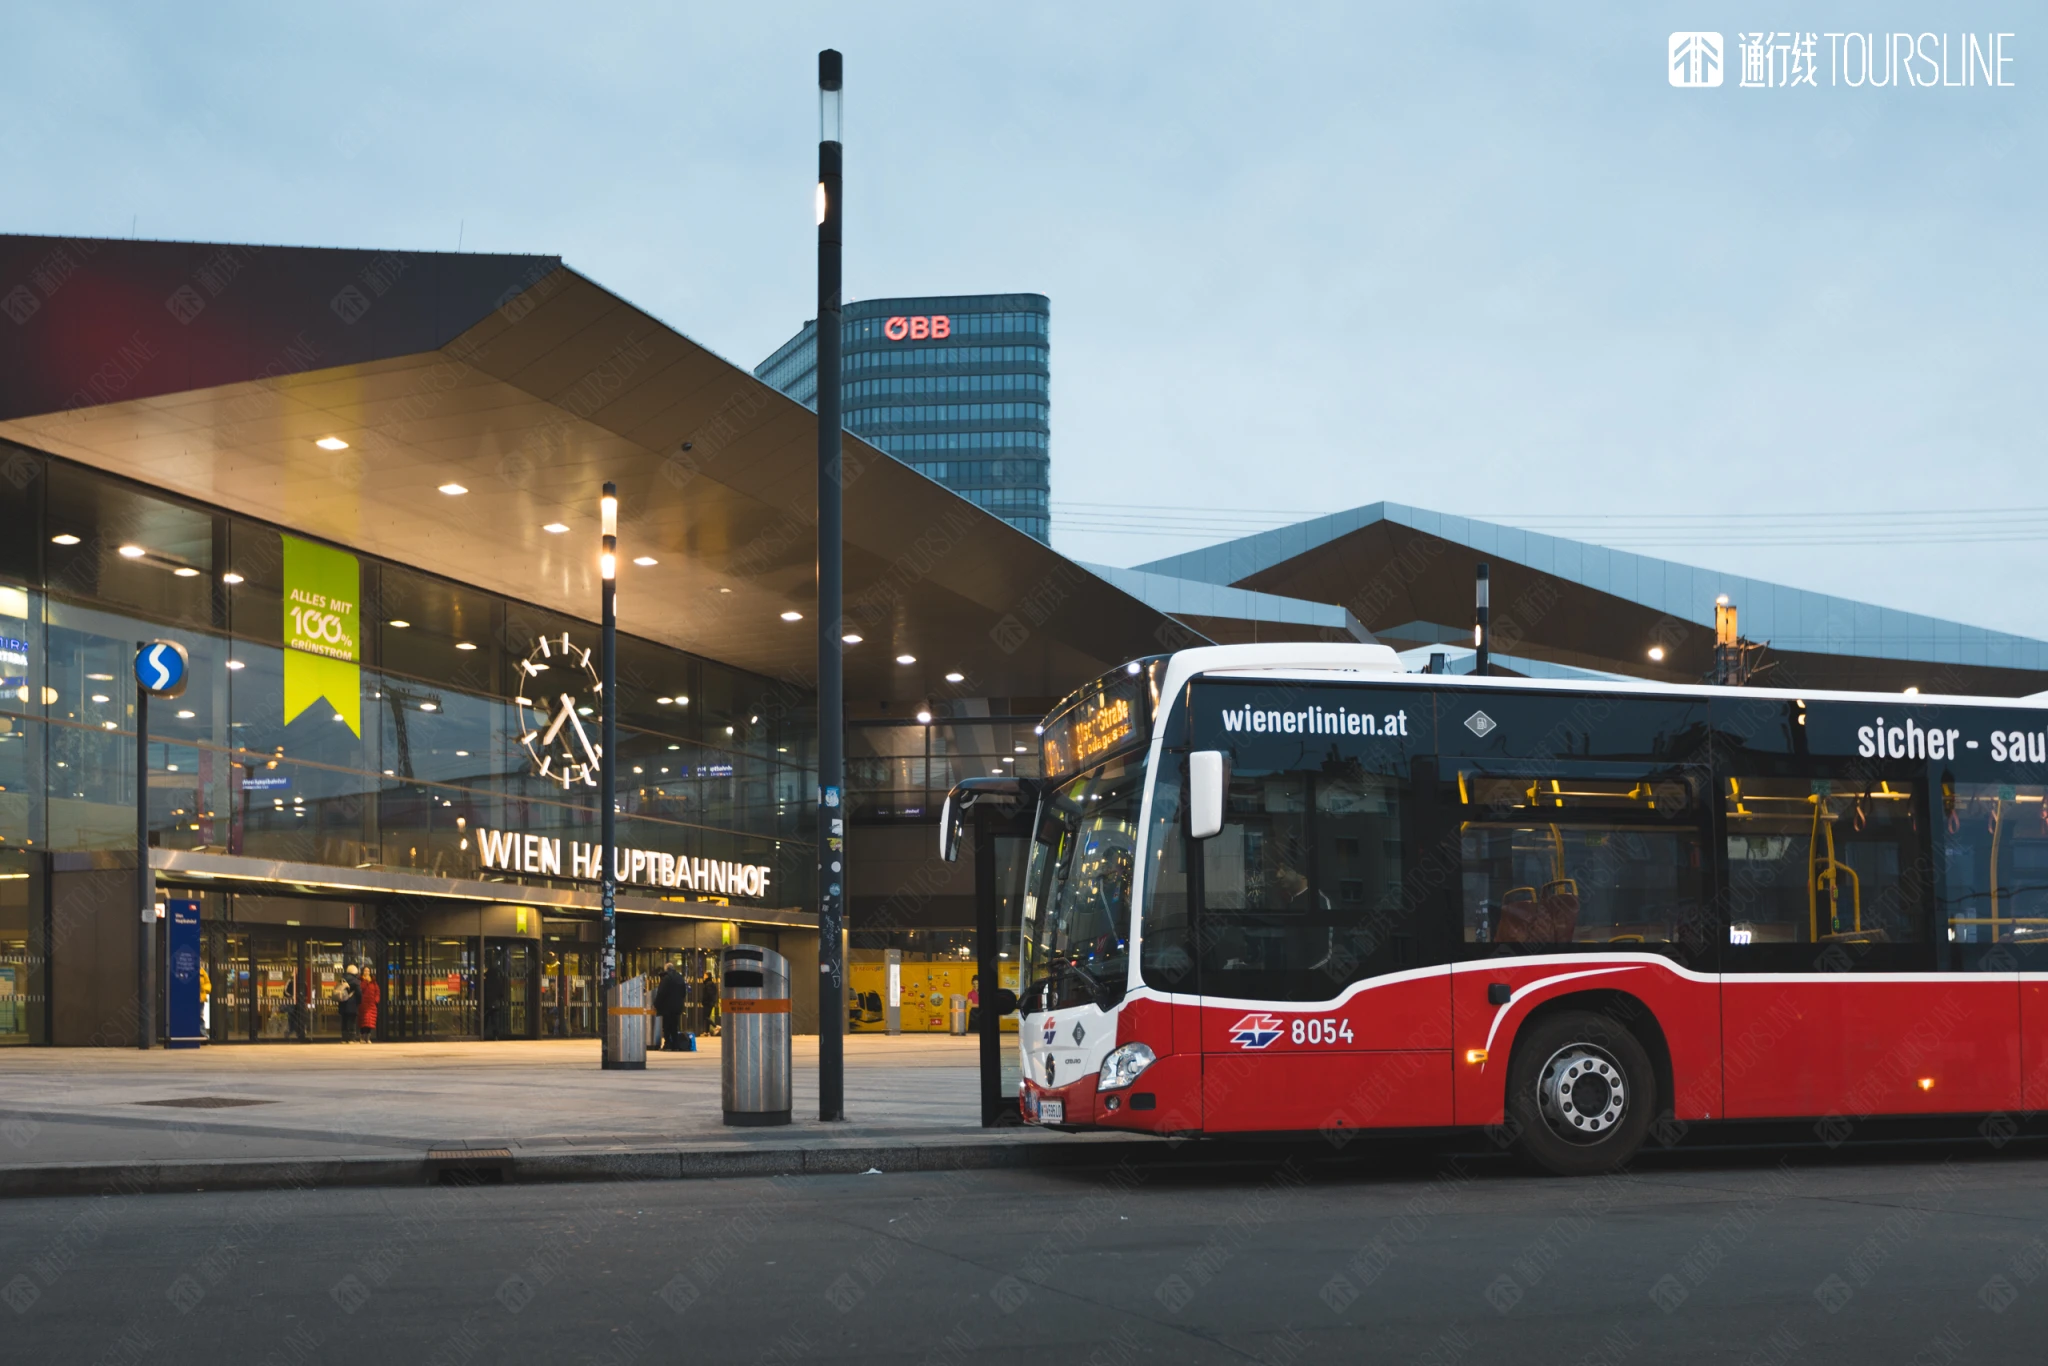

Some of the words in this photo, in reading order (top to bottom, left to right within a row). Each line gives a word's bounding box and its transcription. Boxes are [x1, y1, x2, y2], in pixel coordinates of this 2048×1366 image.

[289, 588, 327, 609] ALLES
[329, 598, 353, 615] MIT
[291, 638, 353, 661] GRÜNSTROM
[1222, 703, 1408, 736] wienerlinien.at
[1857, 716, 1960, 761] sicher
[475, 827, 561, 875] WIEN
[568, 840, 771, 897] HAUPTBAHNHOF
[1291, 1018, 1354, 1045] 8054
